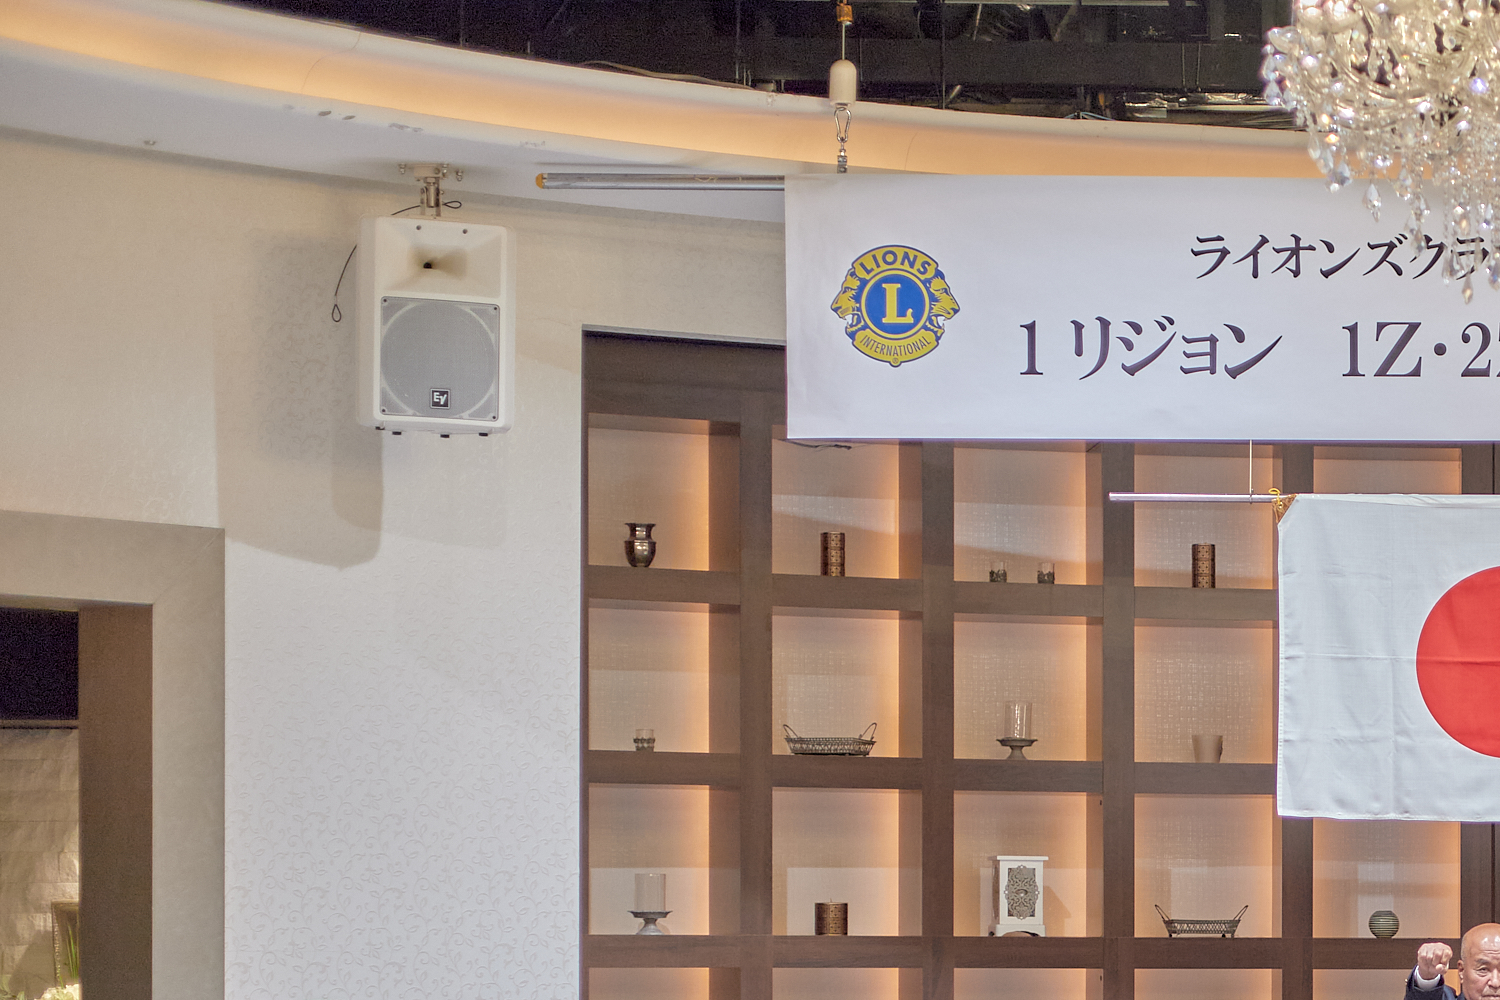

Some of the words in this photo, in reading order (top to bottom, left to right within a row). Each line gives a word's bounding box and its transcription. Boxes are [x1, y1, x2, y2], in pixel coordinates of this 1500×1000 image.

[858, 249, 932, 276] LIONS
[881, 283, 914, 324] L
[859, 335, 932, 357] INTERNATIONAL
